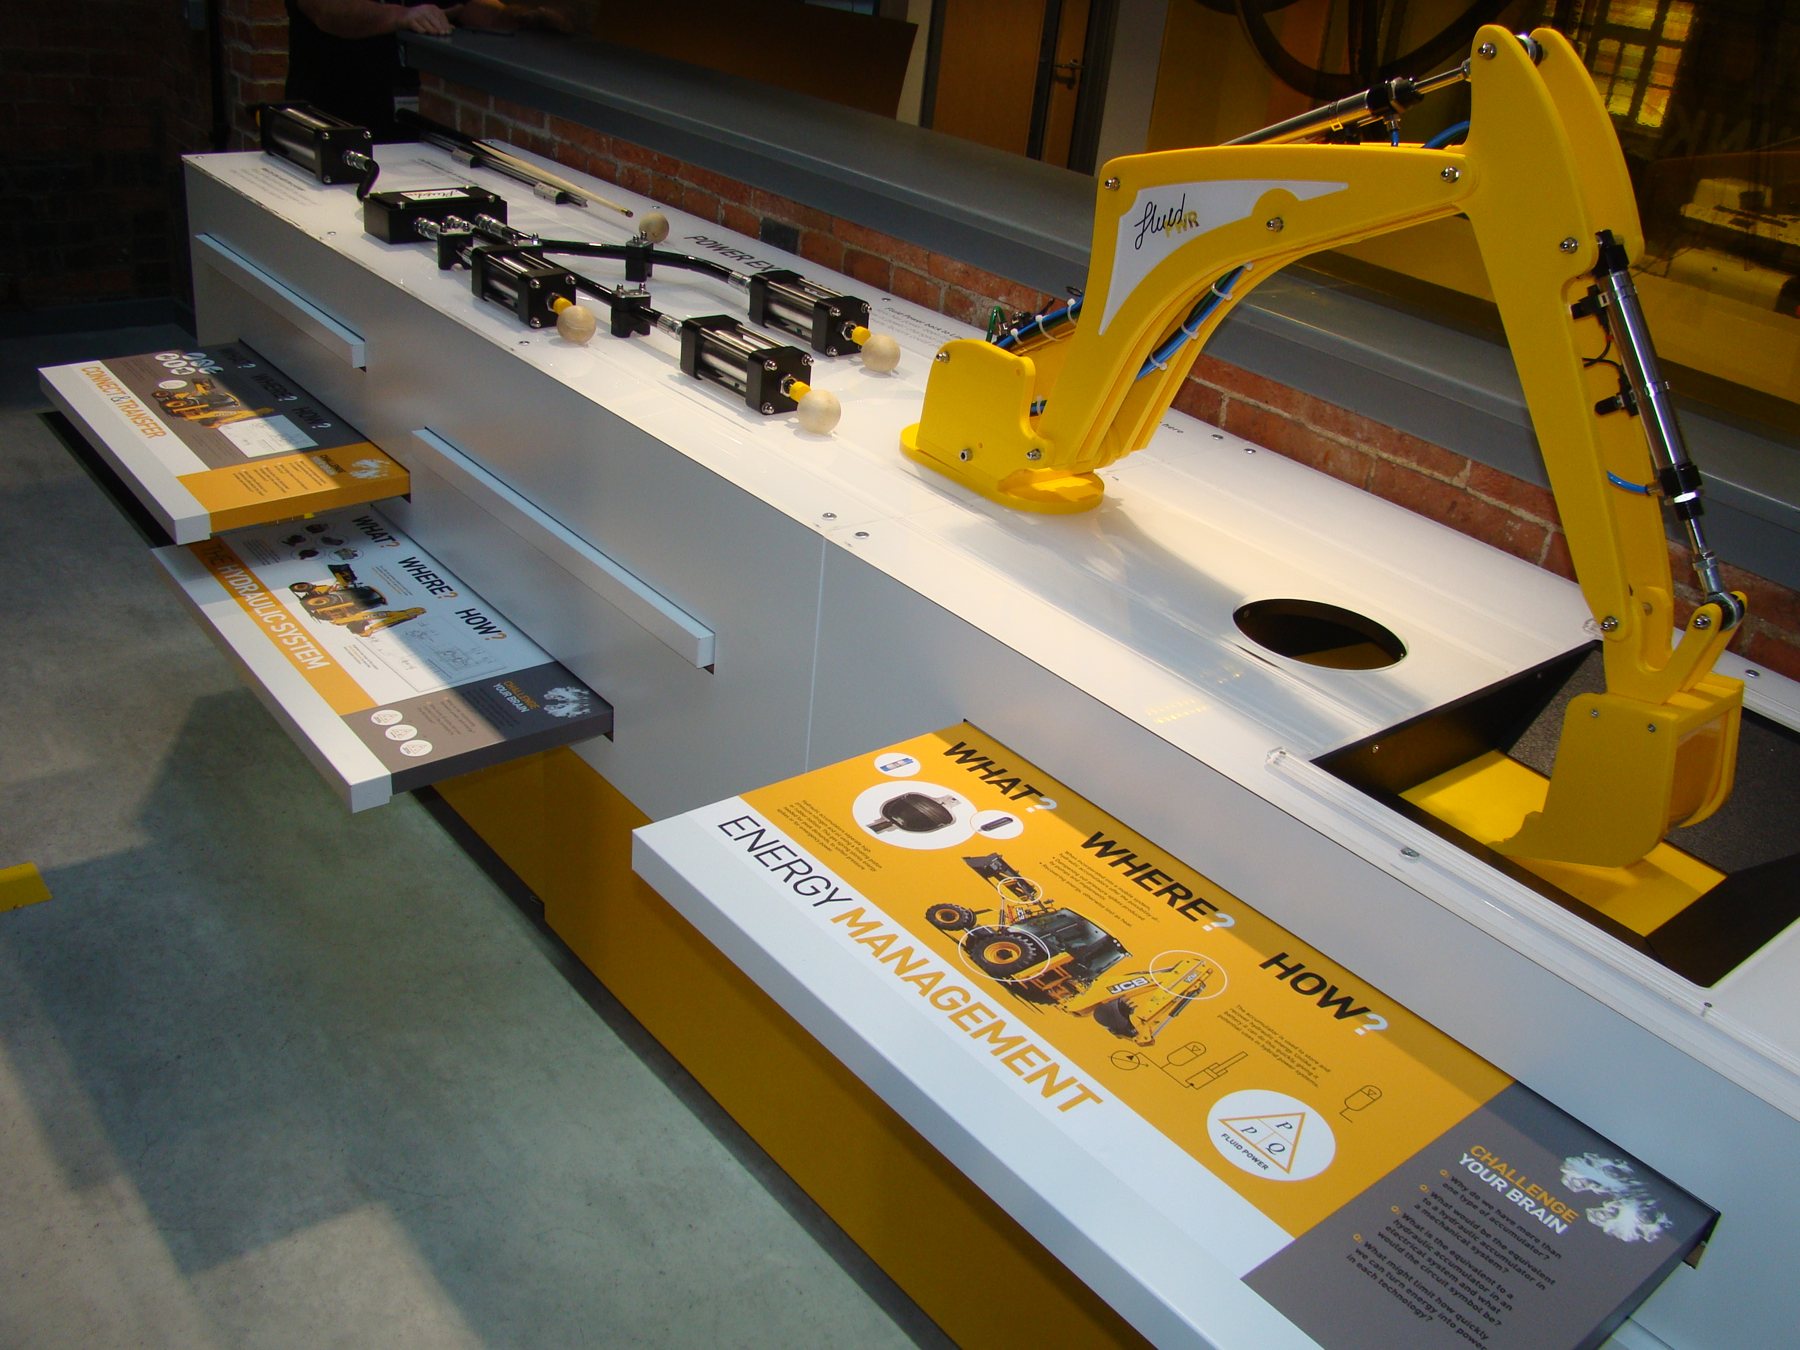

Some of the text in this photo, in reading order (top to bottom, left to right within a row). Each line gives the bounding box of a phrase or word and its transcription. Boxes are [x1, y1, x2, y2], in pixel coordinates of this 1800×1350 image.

[684, 235, 755, 262] POWER
[80, 365, 127, 398] CONNECT
[117, 397, 167, 439] TRANSFER
[291, 405, 332, 429] HOW?
[352, 515, 401, 548] WHAT?
[201, 544, 233, 566] THE
[217, 564, 287, 623] HYDRAULIC
[271, 621, 331, 670] SYSTEM
[398, 556, 459, 600] WHERE?
[455, 608, 507, 641] HOW?
[492, 683, 531, 713] YOUR BRAIN
[943, 741, 1057, 815] WHAT?
[1081, 831, 1236, 932] WHERE?
[717, 815, 1103, 1112] ENERGY MANAGEMENT
[1110, 977, 1150, 995] JCB
[1258, 952, 1389, 1036] HOW?
[1221, 1133, 1268, 1170] FLUID POWER
[1266, 1142, 1285, 1155] Q
[1276, 1121, 1293, 1129] P
[1442, 1183, 1459, 1195] one
[1459, 1194, 1478, 1209] type
[1489, 1217, 1549, 1260] accumulator?
[1450, 1176, 1469, 1191] Why
[1469, 1191, 1481, 1200] do
[1481, 1199, 1494, 1210] we
[1495, 1209, 1516, 1225] have
[1516, 1225, 1540, 1243] more
[1541, 1242, 1562, 1259] than
[1458, 1152, 1570, 1235] YOUR BRAIN
[1470, 1145, 1580, 1224] CHALLENGE
[1385, 1226, 1501, 1314] electrical system and what
[1393, 1219, 1433, 1251] hydraulic
[1434, 1251, 1489, 1292] accumulator
[1499, 1301, 1512, 1311] an
[1402, 1213, 1424, 1232] What
[1433, 1237, 1448, 1250] the
[1449, 1250, 1496, 1285] equivalent
[1421, 1209, 1470, 1246] mechanical
[1471, 1245, 1509, 1273] system?
[1430, 1191, 1453, 1209] What
[1453, 1209, 1480, 1229] would
[1479, 1228, 1492, 1238] be
[1492, 1237, 1507, 1250] the
[1508, 1250, 1555, 1284] equivalent
[1439, 1210, 1479, 1241] hydraulic
[1480, 1241, 1535, 1281] accumulator
[1355, 1248, 1487, 1350] we can turn energy into power
[1356, 1262, 1378, 1280] each
[1378, 1279, 1433, 1321] technology?
[1364, 1241, 1387, 1261] What
[1386, 1260, 1413, 1282] might
[1413, 1279, 1435, 1298] limit
[1434, 1297, 1455, 1313] how
[1455, 1313, 1488, 1340] quickly
[1377, 1231, 1502, 1325] would the circuit symbol be?
